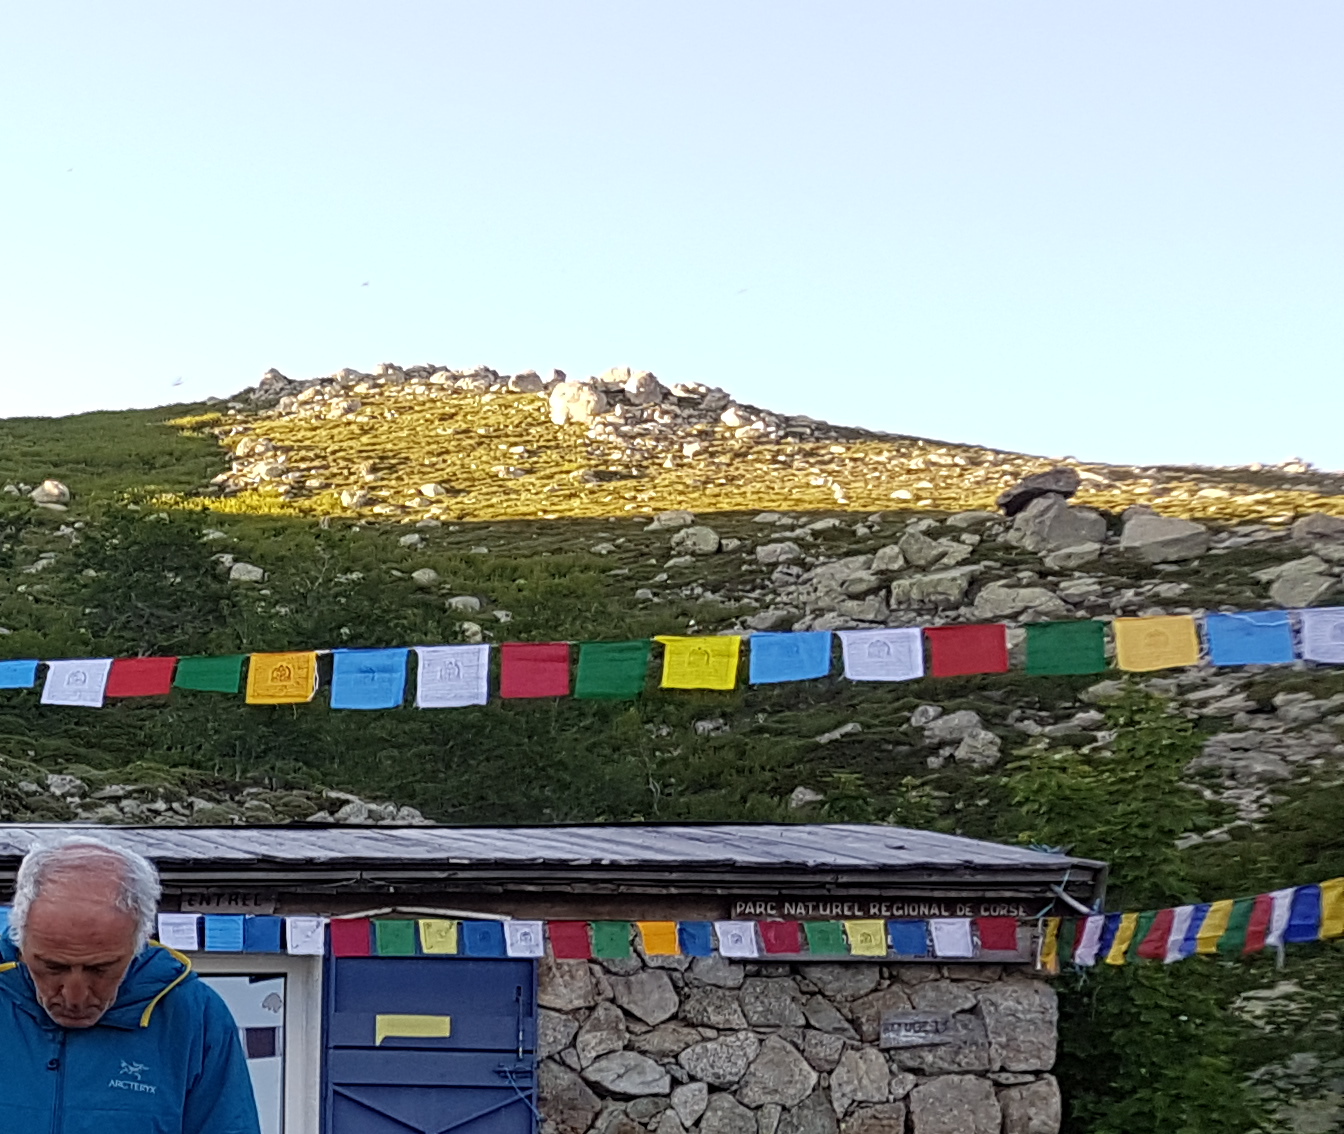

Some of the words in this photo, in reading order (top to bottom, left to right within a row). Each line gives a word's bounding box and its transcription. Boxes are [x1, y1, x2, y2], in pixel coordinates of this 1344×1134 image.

[735, 901, 777, 916] PARC
[783, 901, 863, 916] NATUREL
[869, 901, 949, 917] REGIONAL
[955, 902, 974, 917] DE
[979, 902, 1028, 918] CORSE
